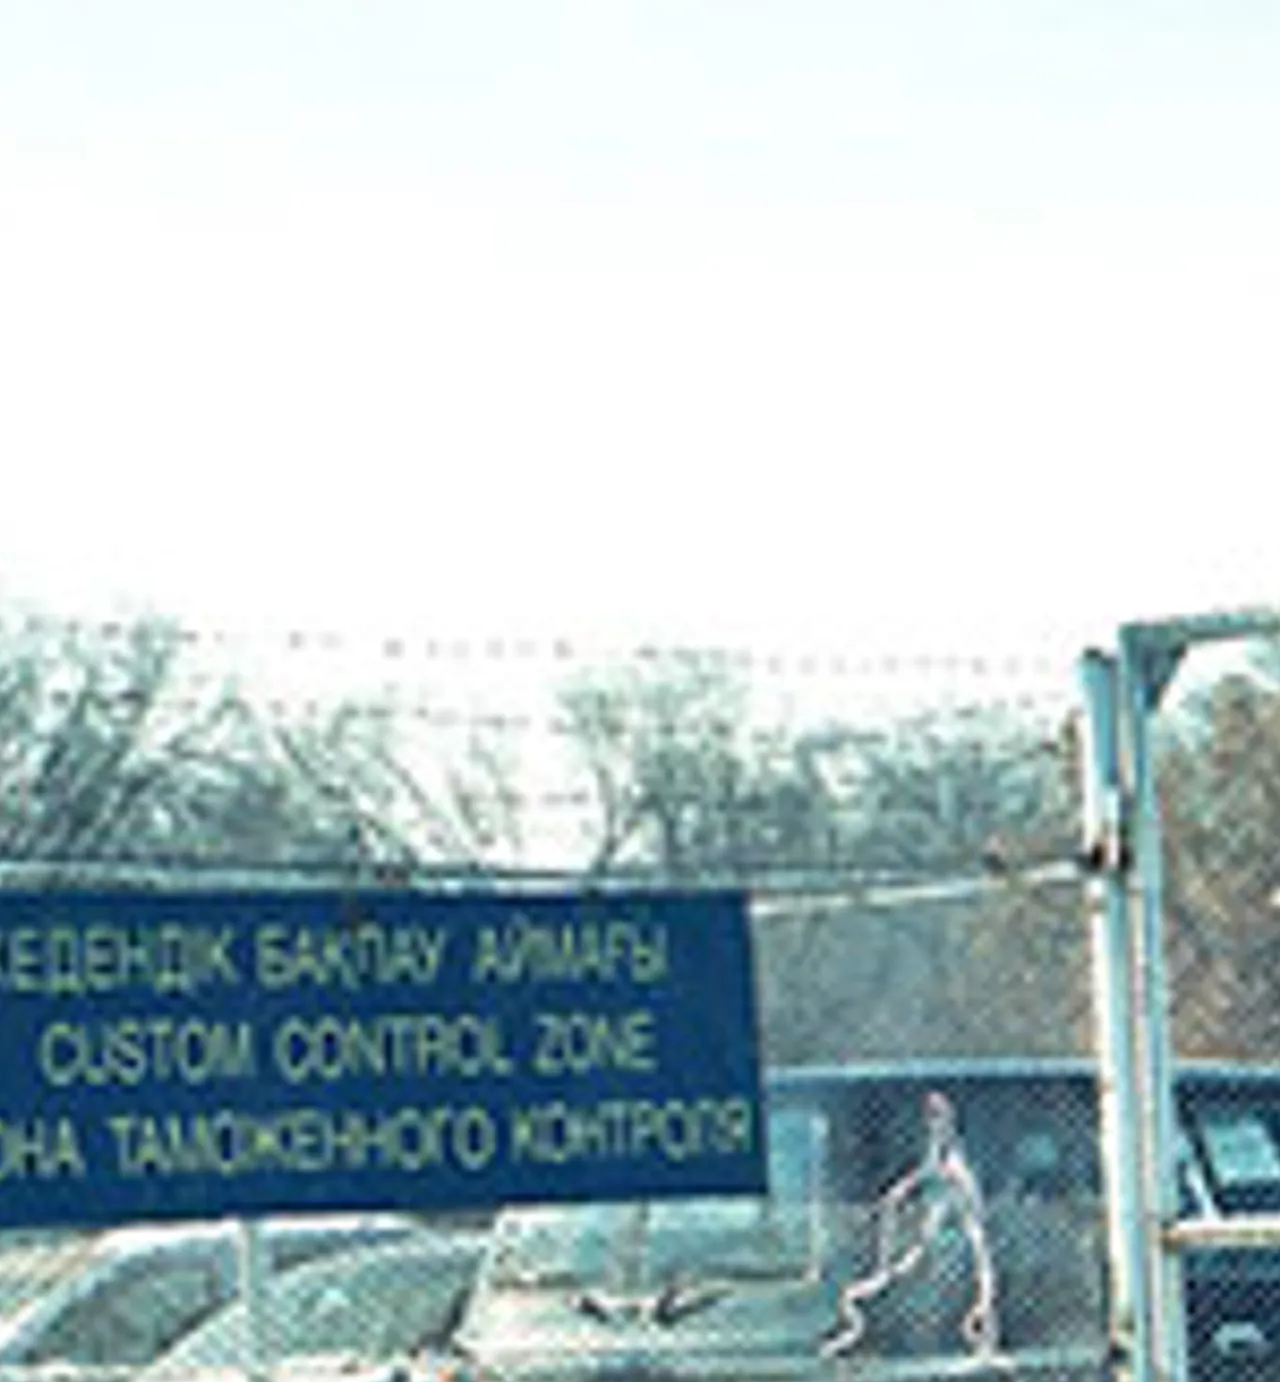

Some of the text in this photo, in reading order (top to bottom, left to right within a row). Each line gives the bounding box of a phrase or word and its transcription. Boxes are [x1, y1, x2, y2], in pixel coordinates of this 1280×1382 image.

[39, 1010, 657, 1088] CUSTOM CONTROL ZONE
[110, 1106, 497, 1176] ТАМОЖЕННОГО
[509, 1096, 751, 1164] КОНТРОЛЯ
